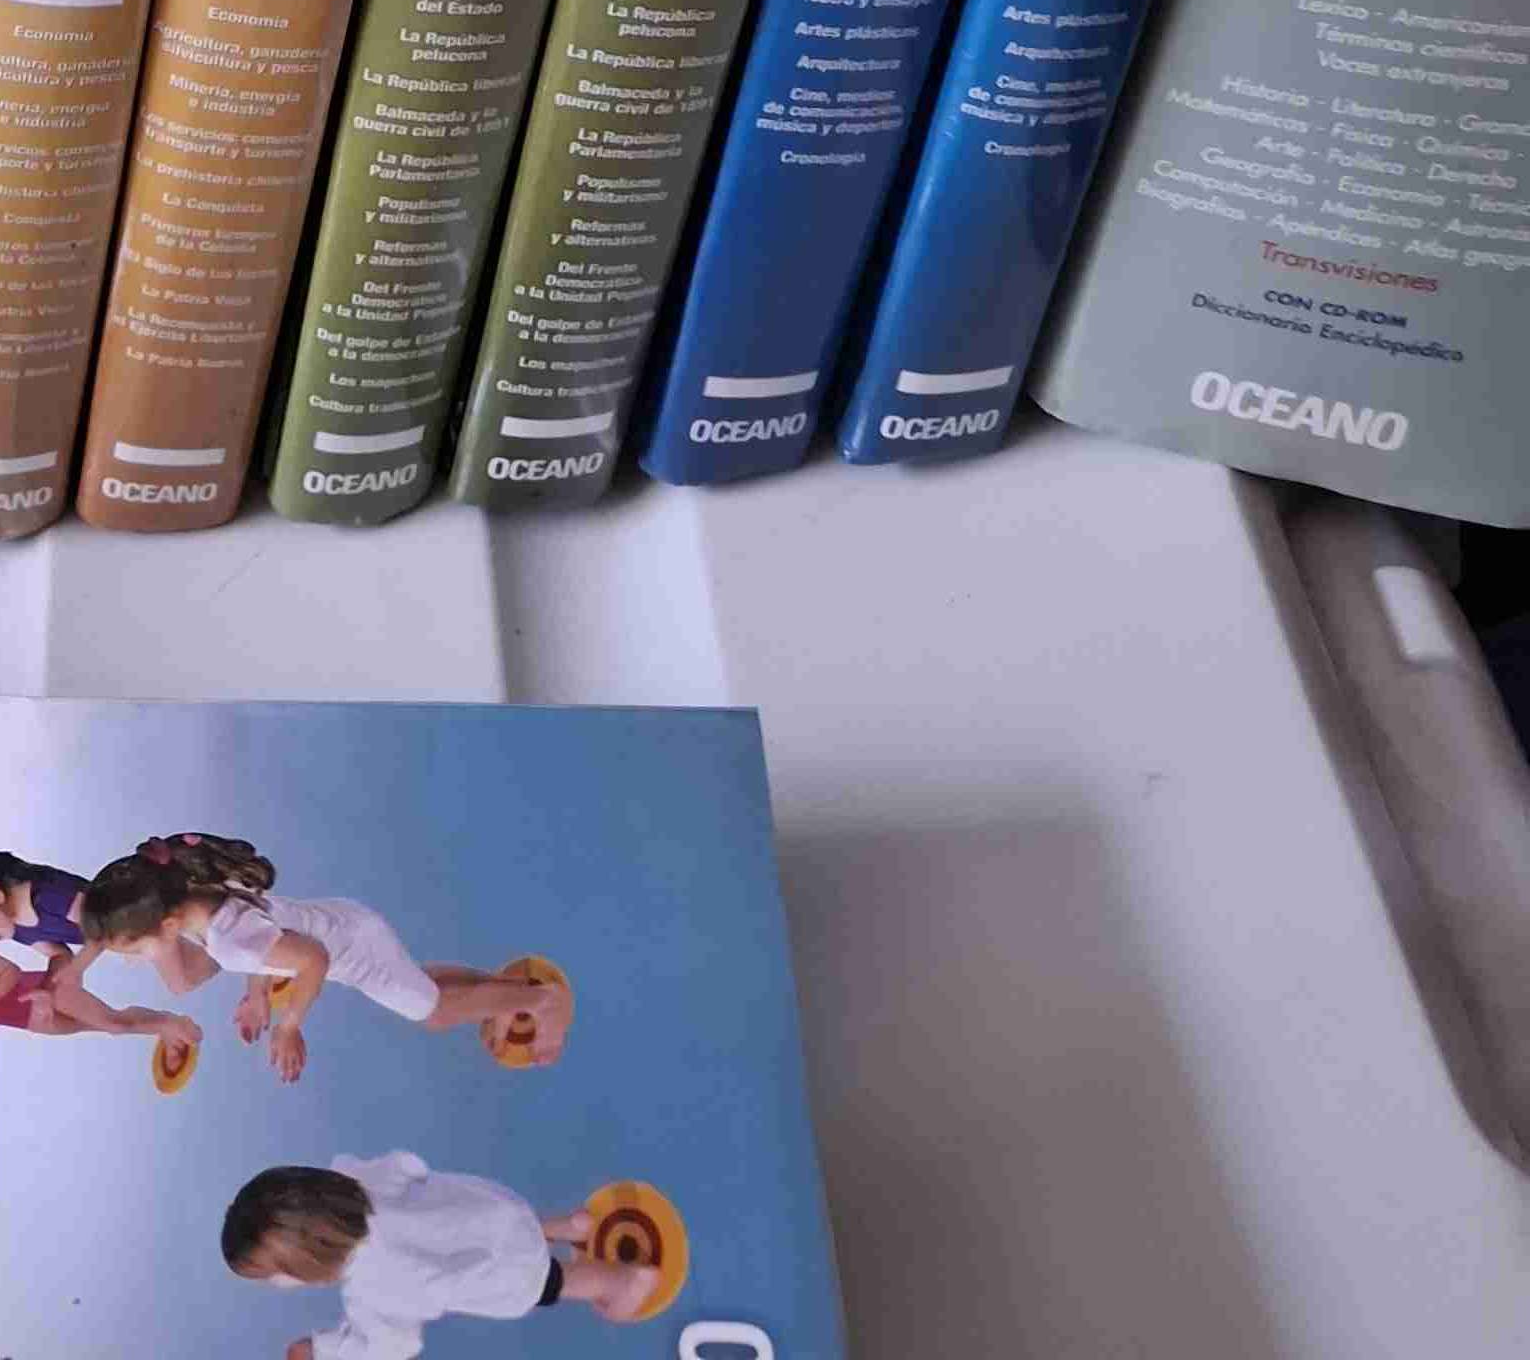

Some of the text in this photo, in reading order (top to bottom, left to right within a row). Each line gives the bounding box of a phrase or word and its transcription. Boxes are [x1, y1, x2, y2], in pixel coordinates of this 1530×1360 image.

[208, 6, 288, 29] Economía
[416, 1, 503, 15] del Estado
[400, 28, 505, 47] La República
[387, 74, 468, 92] República
[1262, 240, 1438, 293] Transvisiones
[1264, 289, 1407, 328] CON CD-ROM
[1191, 293, 1464, 364] Diccionario Enciclopédico
[879, 409, 998, 440] OCEANO
[1190, 370, 1409, 452] OCEANO
[689, 413, 807, 444] OCEANO
[304, 464, 417, 495] OCEANO
[487, 453, 604, 480] OCEANO
[102, 478, 217, 503] OCEANO
